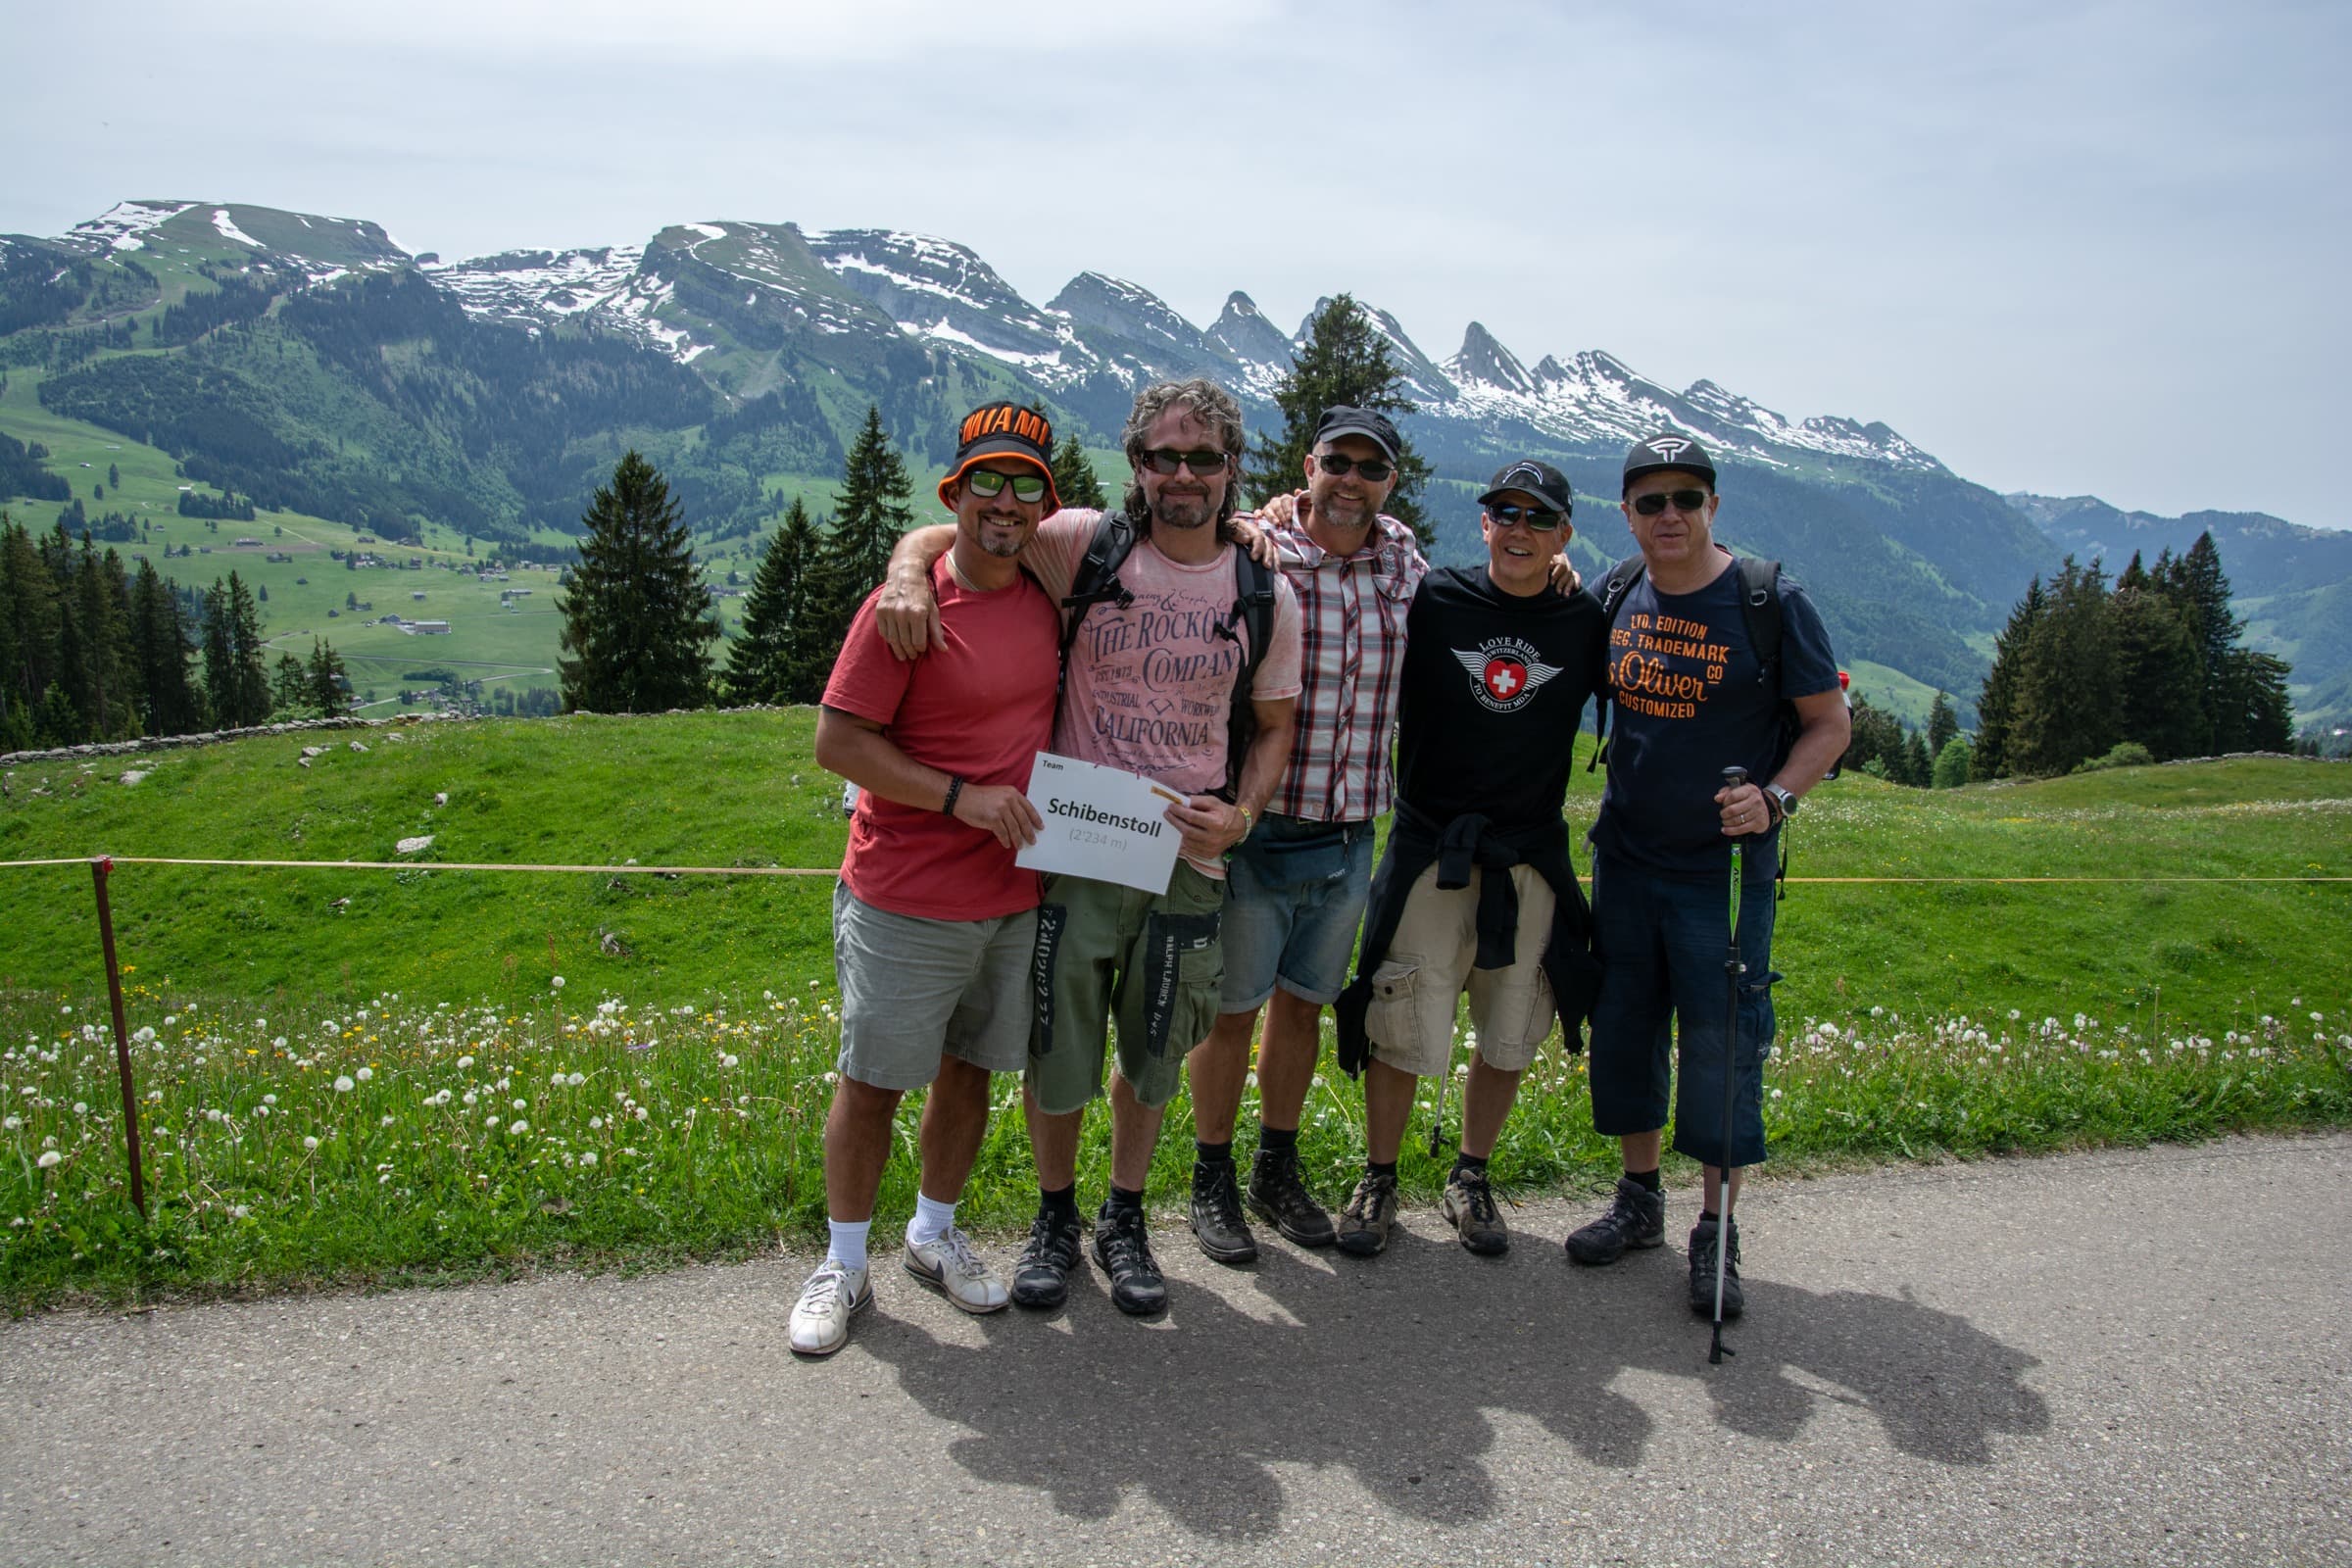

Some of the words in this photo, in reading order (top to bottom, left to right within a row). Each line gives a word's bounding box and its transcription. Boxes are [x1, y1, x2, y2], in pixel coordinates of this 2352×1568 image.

[962, 407, 1049, 447] MIAMI
[1091, 615, 1136, 662] THE
[1631, 613, 1652, 629] LTD.
[1656, 614, 1708, 640] EDITION
[1478, 636, 1512, 654] LOVE
[1486, 647, 1533, 665] SWITZERLAND
[1638, 633, 1731, 663] TRADEMARK
[1143, 647, 1241, 693] COMPAN
[1707, 664, 1723, 681] CO
[1473, 683, 1483, 696] TO
[1480, 693, 1512, 710] BENEFIT
[1512, 692, 1530, 709] MDA
[1618, 690, 1695, 718] CUSTOMIZED
[1095, 705, 1208, 747] CALIFORNIA
[1042, 760, 1064, 772] Team
[1047, 798, 1162, 838] Schibenstoll
[1109, 838, 1128, 852] m)
[1163, 935, 1174, 968] RALPH
